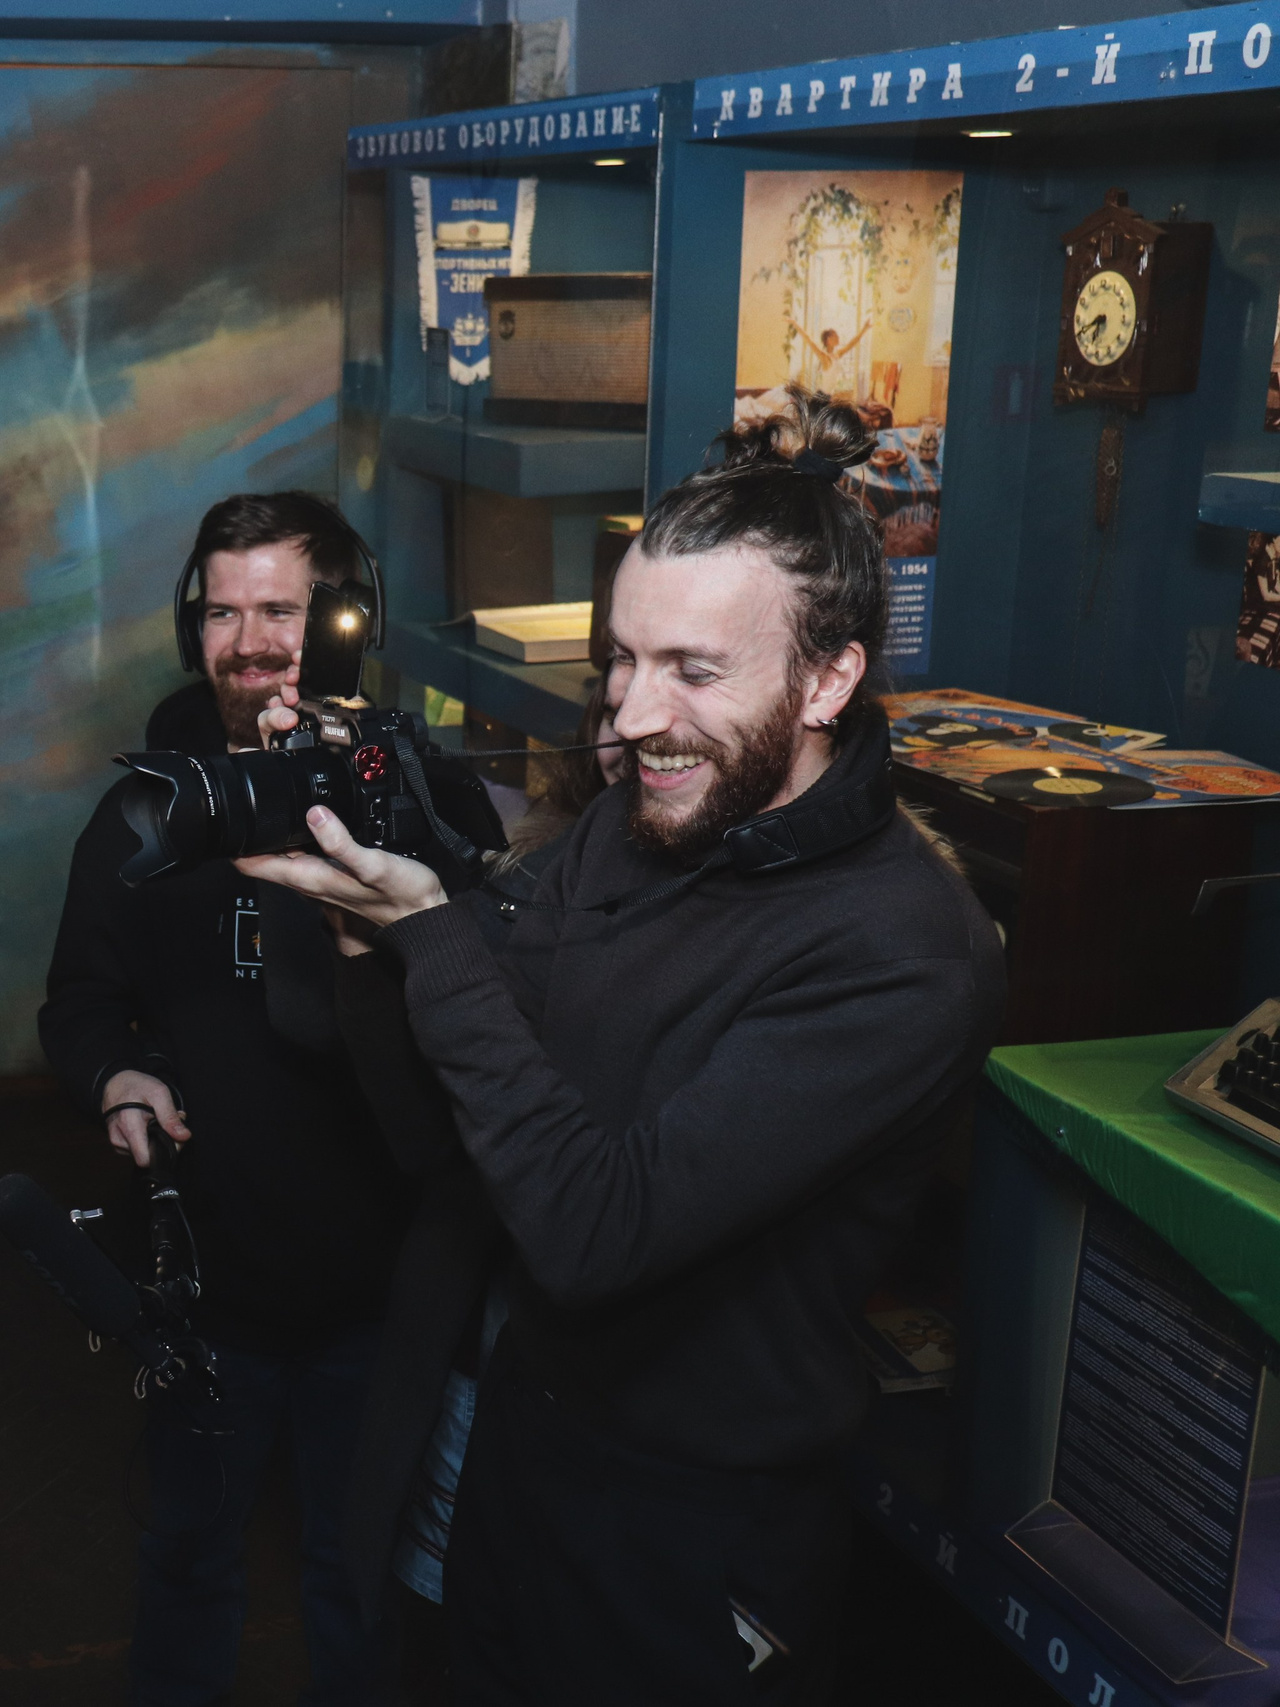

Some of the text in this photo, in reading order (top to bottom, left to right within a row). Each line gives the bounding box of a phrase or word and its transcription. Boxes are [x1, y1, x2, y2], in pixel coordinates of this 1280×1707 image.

[720, 22, 1273, 121] КВАРТИРА 2-Й ПО
[356, 104, 642, 159] ЗВУКОВОЕ ОБОРУДОВАНИЕ
[901, 563, 929, 576] 1954
[324, 725, 346, 738] FUJIFILM
